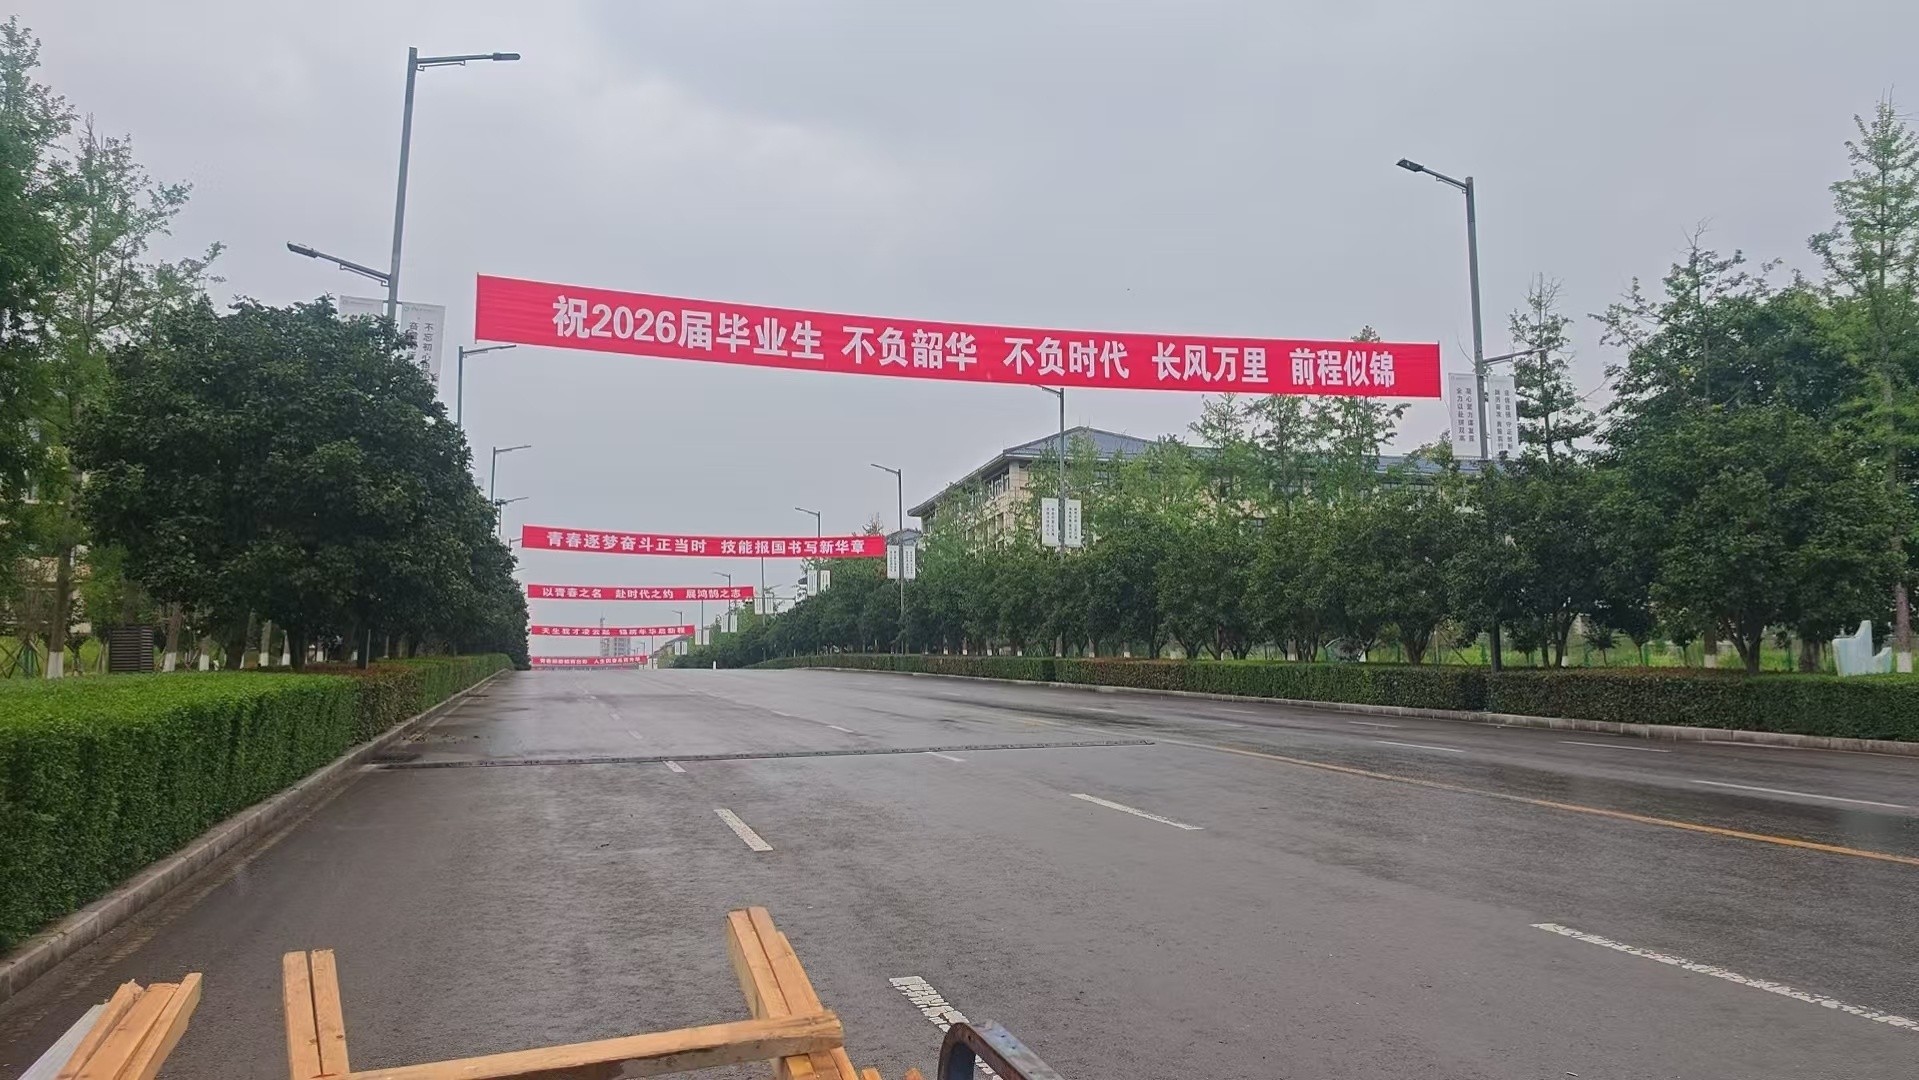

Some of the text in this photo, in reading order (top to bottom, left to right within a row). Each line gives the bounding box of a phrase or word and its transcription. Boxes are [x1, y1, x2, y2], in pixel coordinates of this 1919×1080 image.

[552, 295, 1396, 388] 祝2026届毕业生 不负韶华 不负时代 长风万里 前程似锦
[547, 531, 866, 556] 青春逐梦奋斗正当时 技能报国书写新华章
[542, 587, 741, 599] 以青春之名 赴时代之约 展鸿鹄之志
